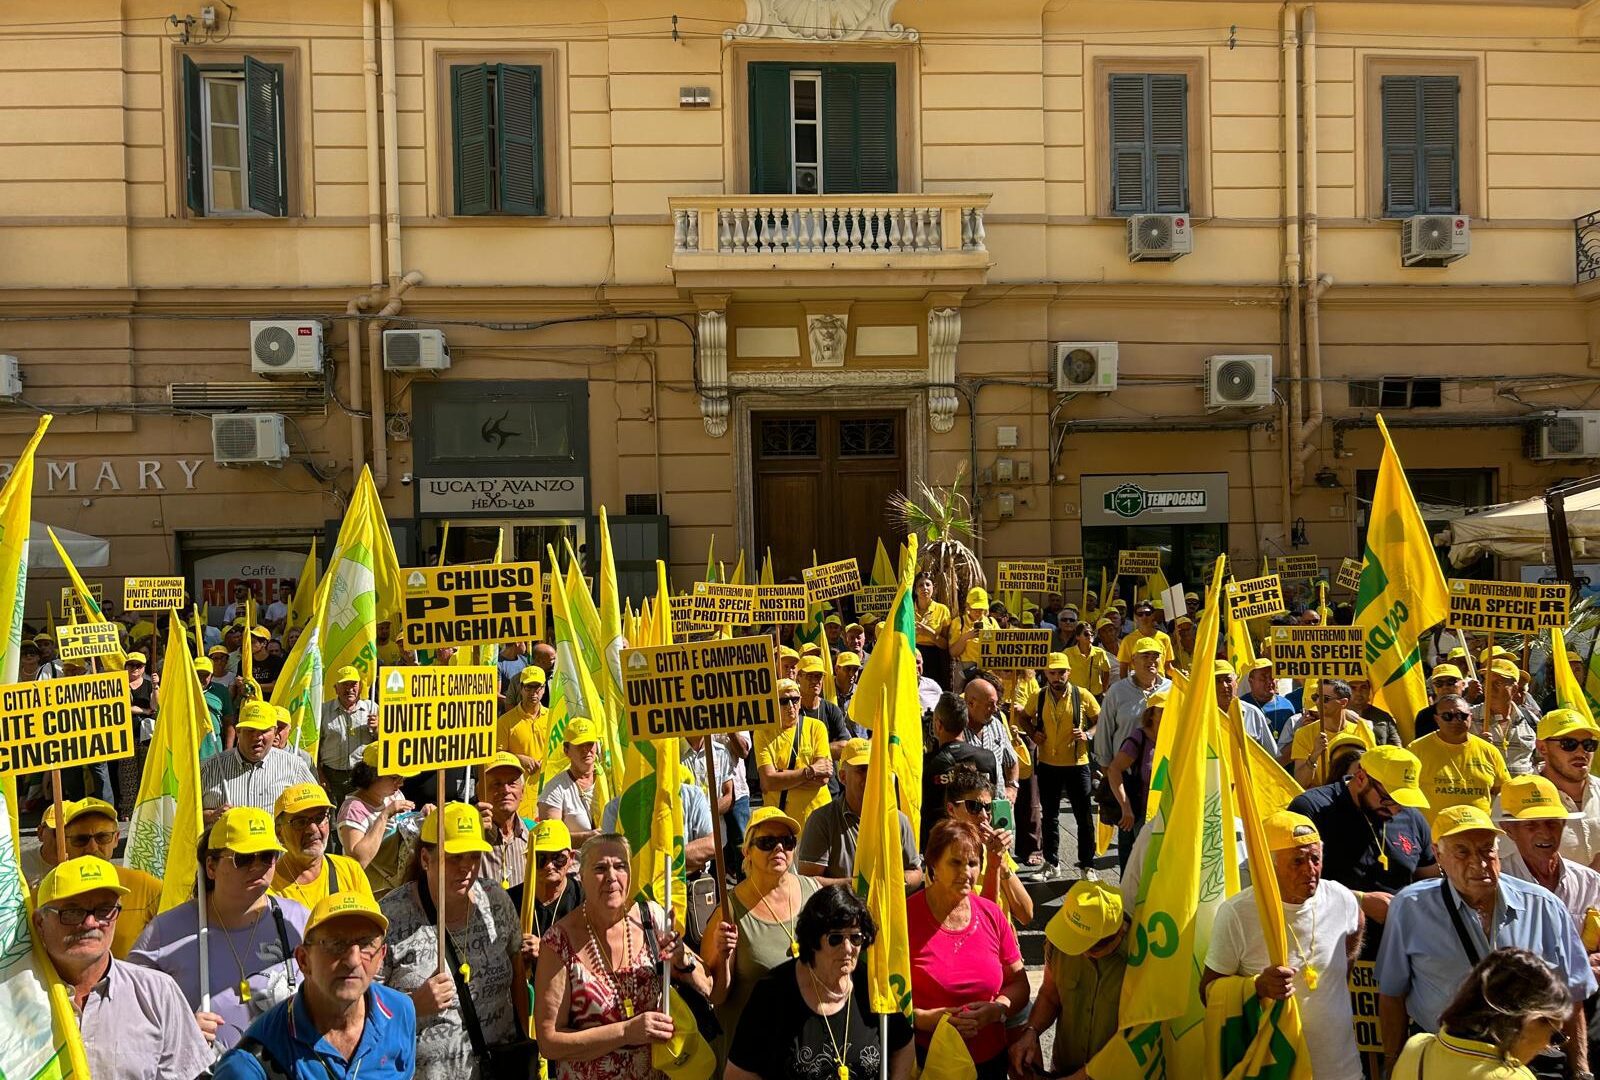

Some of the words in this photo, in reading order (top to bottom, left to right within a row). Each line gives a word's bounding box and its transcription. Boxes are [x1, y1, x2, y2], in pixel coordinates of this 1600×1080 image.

[430, 481, 476, 495] LUCA
[472, 495, 534, 510] HEAD-LAB
[1148, 492, 1204, 506] TEMPOCASA
[436, 567, 534, 592] CHIUSO
[807, 578, 828, 590] UNITE
[830, 570, 858, 585] CONTRO
[1010, 572, 1045, 581] NOSTRO
[758, 587, 805, 596] DIFENDIAMO
[815, 581, 860, 600] CINGHIALI
[1000, 581, 1045, 590] TERRITORIO
[1240, 578, 1278, 593] CHIUSO
[1469, 583, 1521, 597] DIVENTEREMO
[1524, 587, 1537, 598] NOI
[126, 589, 150, 598] UNITE
[152, 588, 182, 598] CONTRO
[1230, 588, 1280, 608] PER
[133, 599, 181, 608] CINGHIALI
[406, 592, 535, 620] PER
[695, 597, 715, 608] UNA
[719, 598, 752, 610] SPECIE
[760, 599, 805, 609] NOSTRO
[1232, 600, 1282, 620] CINGHIALI
[1451, 597, 1481, 611] UNA
[1486, 599, 1536, 615] SPECIE
[693, 610, 750, 623] PROTETTA
[753, 611, 805, 622] ERRITORIO
[1450, 613, 1534, 631] PROTETTA
[73, 624, 115, 634] CHIUSO
[407, 615, 536, 645] CINGHIALI
[1292, 630, 1345, 641] DIVENTEREMO
[1348, 629, 1362, 641] NOI
[60, 634, 116, 646] PER
[995, 631, 1049, 642] DIFENDIAMO
[62, 644, 118, 657] CINGHIALI
[981, 644, 992, 655] IL
[997, 643, 1048, 655] NOSTRO
[1275, 645, 1308, 658] UNA
[1311, 645, 1362, 659] SPECIE
[656, 646, 689, 673] CITTÀ
[692, 650, 699, 669] E
[701, 643, 768, 668] CAMPAGNA
[982, 656, 1047, 668] TERRITORIO
[1276, 662, 1363, 676] PROTETTA
[412, 669, 438, 697] CITTÀ
[441, 674, 445, 696] E
[448, 673, 493, 696] CAMPAGNA
[627, 676, 686, 706] UNITE
[690, 667, 772, 700] CONTRO
[4, 684, 41, 711] CITTÀ
[45, 686, 52, 706] E
[56, 678, 123, 705] CAMPAGNA
[43, 701, 126, 736] CONTRO
[384, 702, 432, 734] UNITE
[437, 700, 493, 730] CONTRO
[630, 712, 639, 736] I
[647, 699, 775, 734] CINGHIALI
[383, 740, 389, 768] I
[398, 732, 493, 767] CINGHIALI
